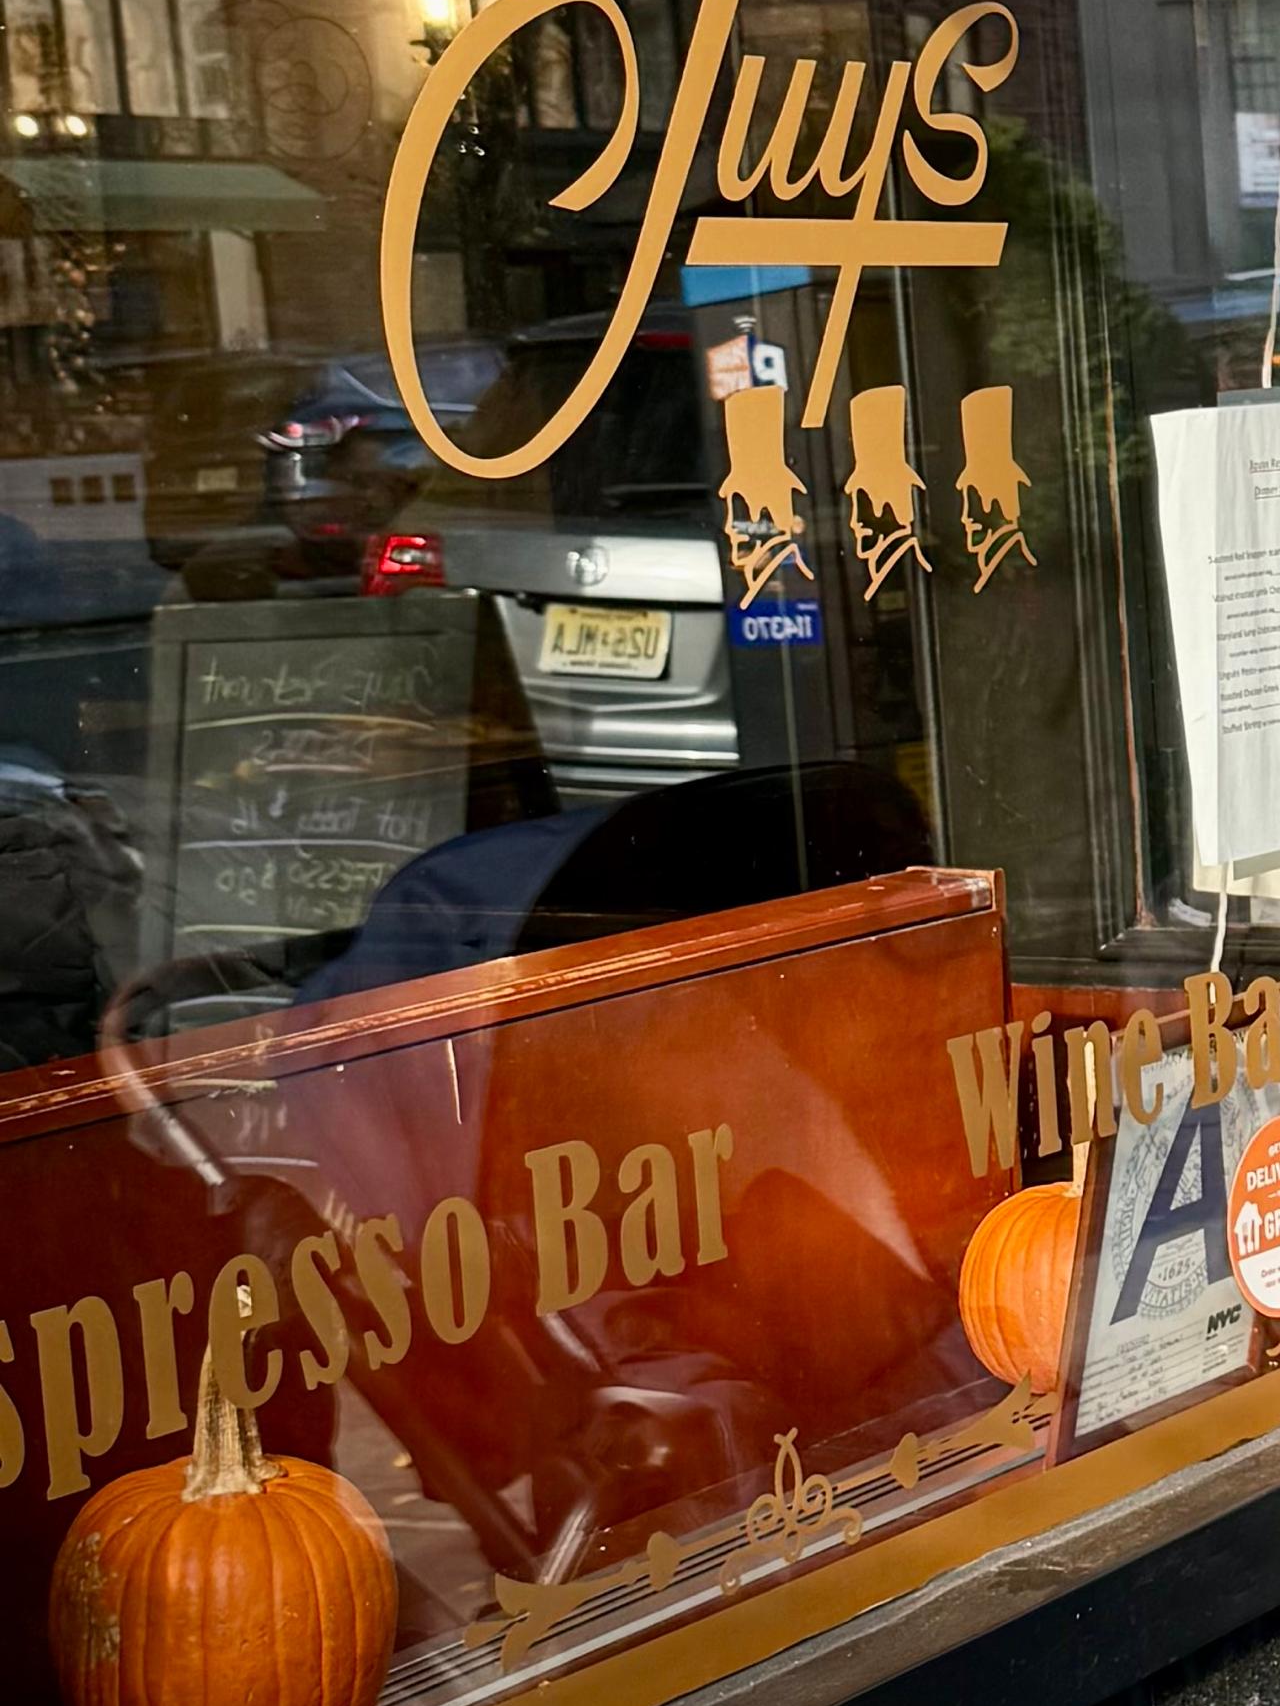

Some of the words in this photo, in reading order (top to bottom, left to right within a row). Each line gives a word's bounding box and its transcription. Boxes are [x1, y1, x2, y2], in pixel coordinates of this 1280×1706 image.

[946, 1008, 1164, 1179] Wine
[523, 1123, 734, 1318] Bar
[1108, 1091, 1236, 1326] A
[1205, 1303, 1243, 1335] NYC
